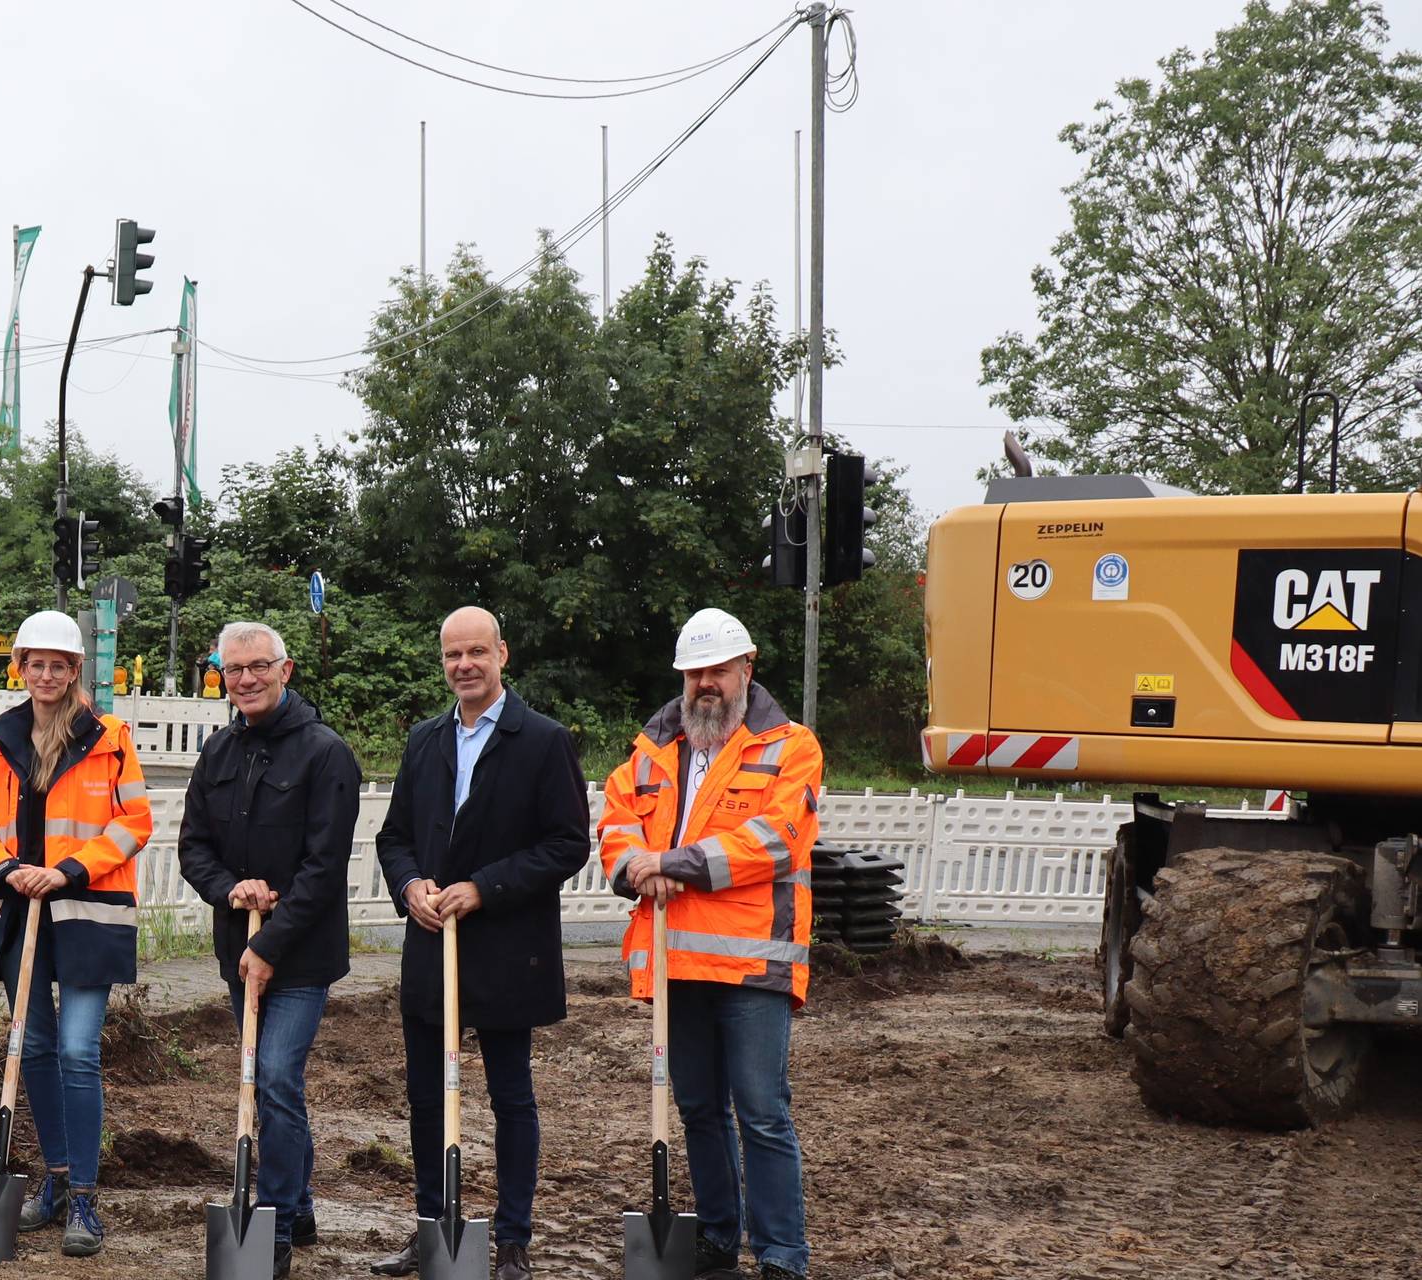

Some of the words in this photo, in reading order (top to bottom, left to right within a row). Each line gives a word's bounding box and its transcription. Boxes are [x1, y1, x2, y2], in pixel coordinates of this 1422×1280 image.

[1036, 522, 1105, 535] ZEPPELIN
[1012, 563, 1047, 589] 20
[1273, 568, 1381, 631] CAT
[690, 632, 712, 643] KSP
[1279, 643, 1376, 673] M318F
[716, 799, 750, 811] KSP
